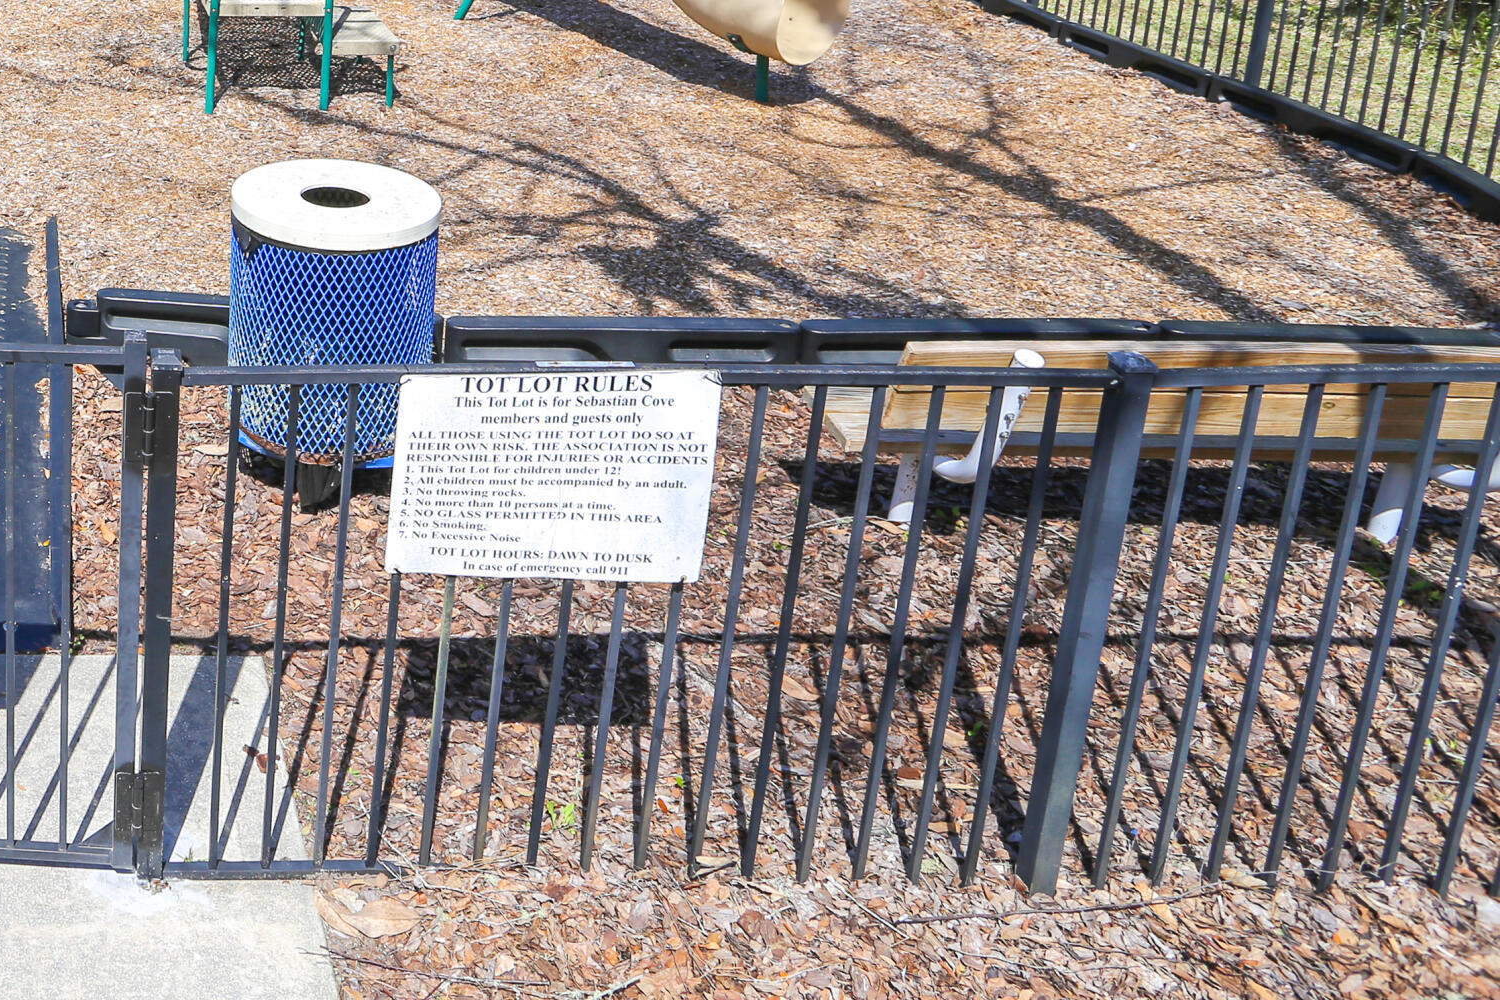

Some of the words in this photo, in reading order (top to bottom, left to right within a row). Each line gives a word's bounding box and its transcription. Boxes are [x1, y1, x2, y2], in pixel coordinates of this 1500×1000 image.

[461, 377, 510, 393] TOT
[517, 377, 567, 393] LOT
[574, 375, 652, 392] RULES
[455, 397, 482, 407] This
[487, 397, 507, 407] Tot
[512, 397, 534, 407] Lot
[538, 397, 548, 407] is
[553, 396, 571, 407] for
[575, 396, 637, 407] Sebastian
[642, 395, 674, 406] Cove
[481, 414, 540, 424] members
[544, 413, 568, 423] and
[572, 414, 611, 425] guests
[616, 413, 644, 426] only
[409, 431, 436, 439] ALL
[439, 431, 485, 439] THOSE
[490, 431, 531, 439] USING
[535, 431, 563, 439] THE
[568, 431, 595, 439] TOT
[600, 431, 628, 439] LOT
[632, 431, 652, 440] DO
[655, 431, 673, 440] SO
[676, 431, 695, 440] AT
[408, 442, 450, 450] THEIR
[493, 443, 528, 451] RISK.
[532, 442, 560, 450] THE
[563, 443, 658, 452] ASSOCIATION
[662, 444, 674, 452] IS
[678, 444, 708, 452] NOT
[406, 454, 501, 462] RESPONSIBLE
[505, 454, 533, 462] FOR
[537, 454, 599, 462] INJURIES
[604, 455, 623, 463] OR
[627, 455, 708, 465] ACCIDENTS
[448, 466, 465, 474] Tot
[470, 466, 489, 474] Lot
[494, 466, 510, 474] for
[514, 466, 561, 474] children
[605, 467, 621, 475] 12!
[438, 477, 485, 485] children
[521, 478, 534, 486] be
[537, 478, 613, 487] accompanied
[618, 479, 631, 489] by
[653, 480, 687, 489] adult.
[436, 488, 488, 497] throwing
[492, 489, 526, 497] rocks.
[468, 500, 494, 508] than
[499, 500, 511, 508] 10
[514, 501, 558, 510] persons
[587, 502, 616, 510] time.
[414, 509, 434, 517] NO
[437, 510, 481, 519] GLASS
[486, 511, 566, 520] PERMITTED
[570, 512, 585, 520] IN
[589, 513, 621, 522] THIS
[624, 514, 662, 523] AREA
[413, 520, 429, 528] No
[399, 531, 407, 539] 7.
[412, 531, 428, 539] No
[431, 531, 486, 541] Excessive
[489, 534, 521, 543] Noise
[429, 547, 457, 557] TOT
[461, 549, 489, 558] LOT
[493, 550, 544, 559] HOURS:
[548, 551, 589, 561] DAWN
[593, 553, 612, 562] TO
[616, 553, 652, 563] DUSK
[463, 561, 475, 570] In
[506, 563, 518, 572] of
[522, 565, 581, 575] emergency
[586, 566, 606, 574] call
[610, 567, 628, 575] 911
